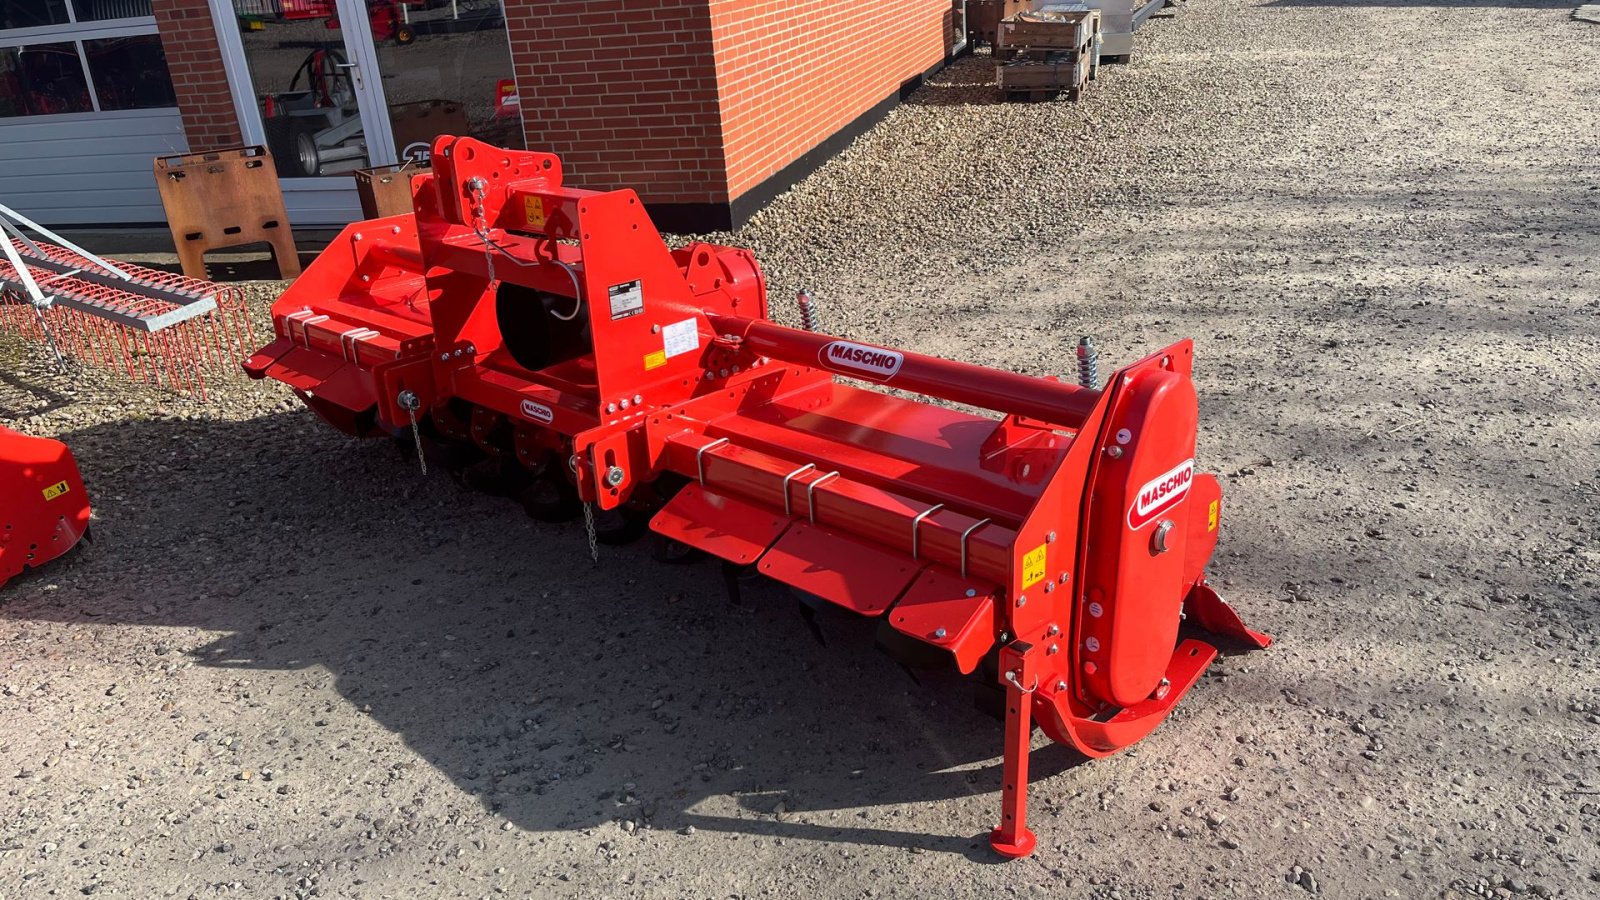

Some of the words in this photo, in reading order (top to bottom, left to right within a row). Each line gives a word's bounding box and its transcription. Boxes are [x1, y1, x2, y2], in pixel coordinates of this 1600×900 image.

[830, 344, 897, 370] MASCHIO
[524, 402, 551, 418] MASCHIO
[1140, 467, 1192, 510] MASCHIO
